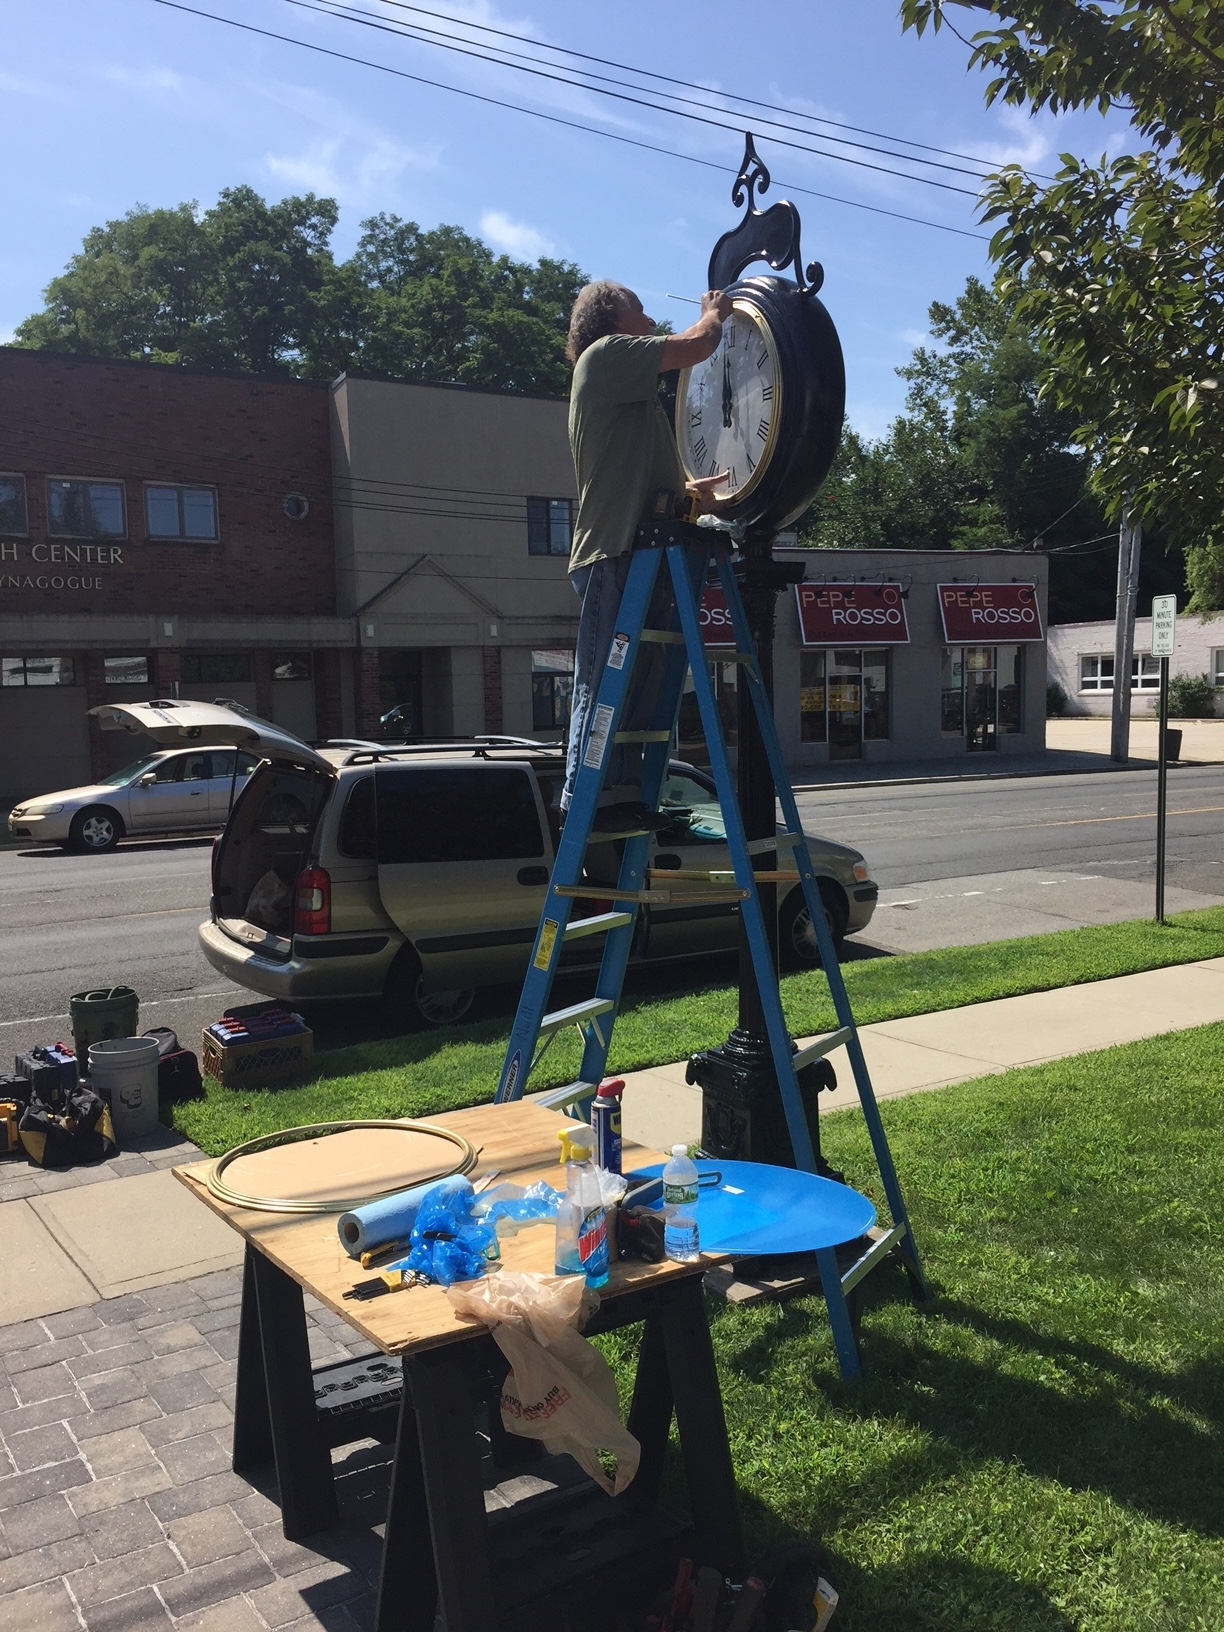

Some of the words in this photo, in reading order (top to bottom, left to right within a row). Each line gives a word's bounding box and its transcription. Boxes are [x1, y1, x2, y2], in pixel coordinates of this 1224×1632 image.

[762, 386, 773, 403] III
[31, 543, 124, 564] CENTER
[0, 574, 103, 590] YNAGOGUE
[801, 591, 857, 607] PEPE
[943, 591, 994, 607] PEPE
[1161, 600, 1168, 609] 30
[699, 608, 733, 625] OSS
[831, 608, 901, 625] ROSSO
[971, 607, 1035, 624] ROSSO
[1157, 611, 1171, 619] MINUTE
[1155, 621, 1172, 629] PARKING
[1158, 631, 1169, 639] ONLY
[543, 1385, 560, 1405] BUY
